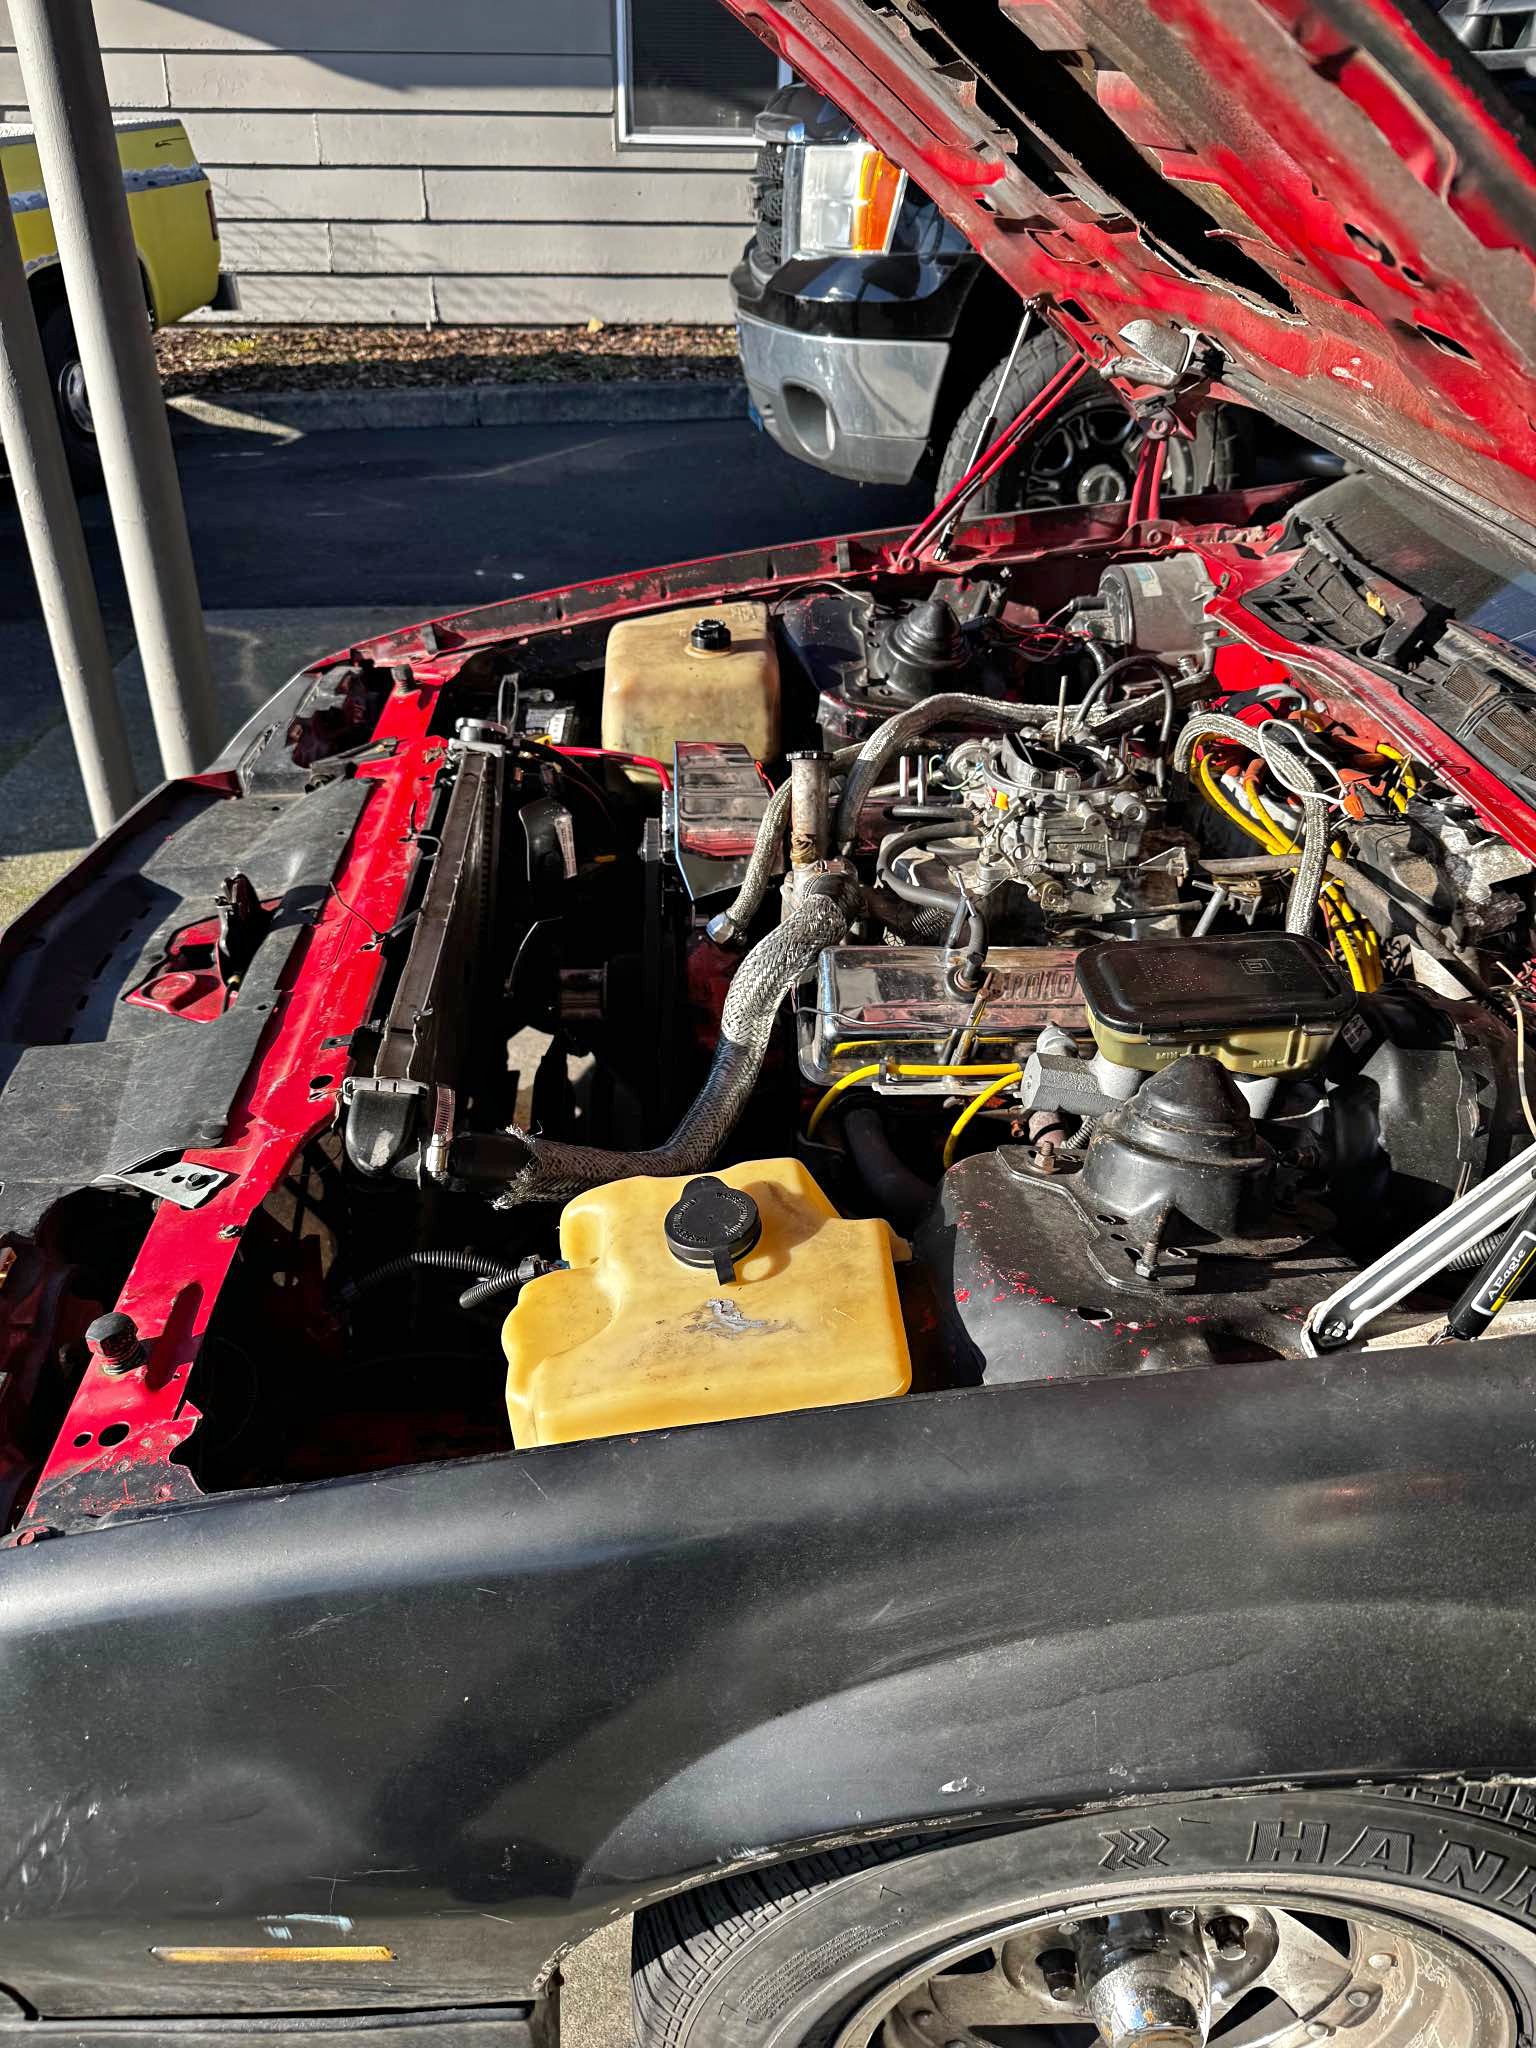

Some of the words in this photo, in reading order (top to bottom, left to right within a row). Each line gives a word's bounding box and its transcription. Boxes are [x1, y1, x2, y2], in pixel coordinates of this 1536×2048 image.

[1155, 1051, 1179, 1061] MIN
[1252, 1059, 1276, 1068] MIN
[1488, 1248, 1527, 1301] AEagle
